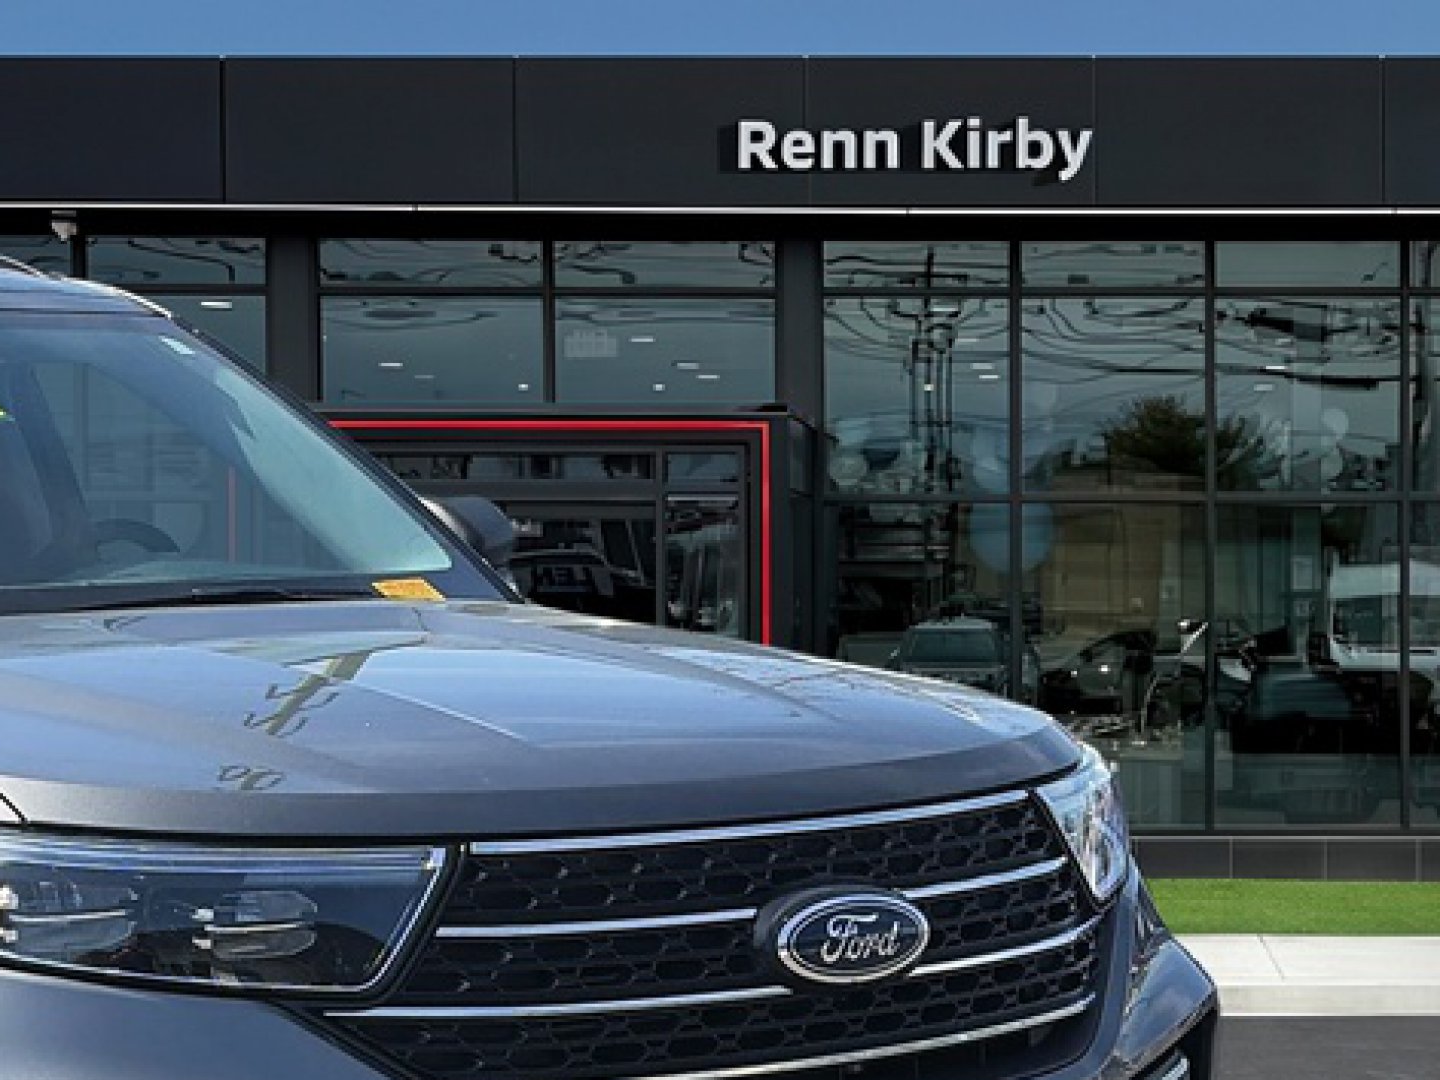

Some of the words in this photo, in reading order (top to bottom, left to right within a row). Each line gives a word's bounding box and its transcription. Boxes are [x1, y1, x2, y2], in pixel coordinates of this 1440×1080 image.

[737, 120, 901, 169] Renn
[920, 115, 1093, 181] Kirby
[821, 913, 900, 963] Ford
